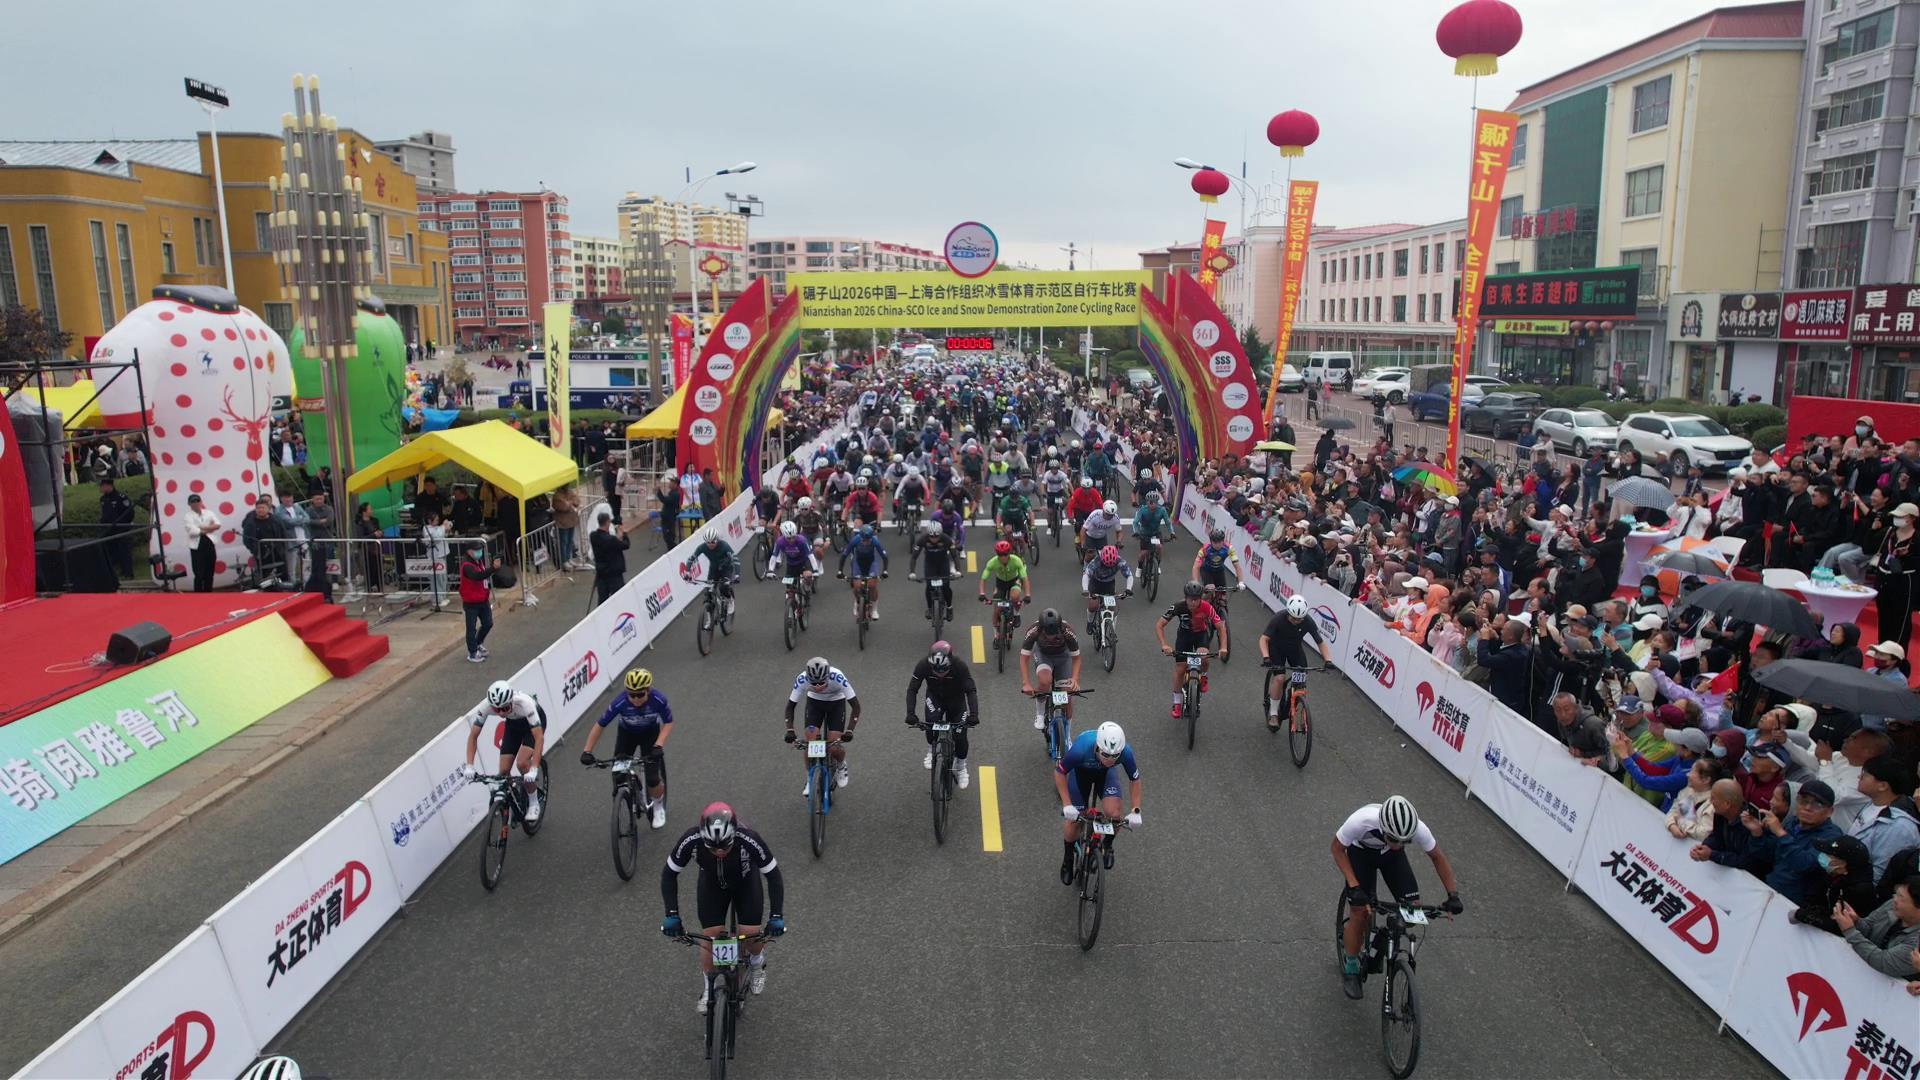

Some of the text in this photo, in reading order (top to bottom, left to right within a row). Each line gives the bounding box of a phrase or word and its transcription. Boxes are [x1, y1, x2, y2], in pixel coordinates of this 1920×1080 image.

[803, 302, 1136, 317] Nianzishan 2026 China-SCO Ice and Snow Demonstration Zone Cycling Race
[1798, 299, 1846, 325] 遇见麻辣烫
[1854, 312, 1920, 332] 床上用
[1215, 356, 1231, 365] SSS
[1270, 572, 1282, 599] SSS
[645, 592, 661, 620] SSS
[1354, 645, 1385, 679] 大正体育
[562, 664, 588, 707] 大正体育
[1053, 694, 1067, 702] 106
[1432, 711, 1465, 753] TITAN
[1436, 695, 1470, 733] 泰坦体育
[0, 690, 199, 811] 骑阅雅鲁河
[1600, 850, 1687, 923] 大正体育
[1625, 842, 1687, 895] DA ZHENG SPORTS
[275, 878, 334, 936] DA ZHENG SPORTS
[267, 888, 343, 989] 大正体育
[715, 945, 734, 960] 121
[1855, 1018, 1920, 1080] 泰坦
